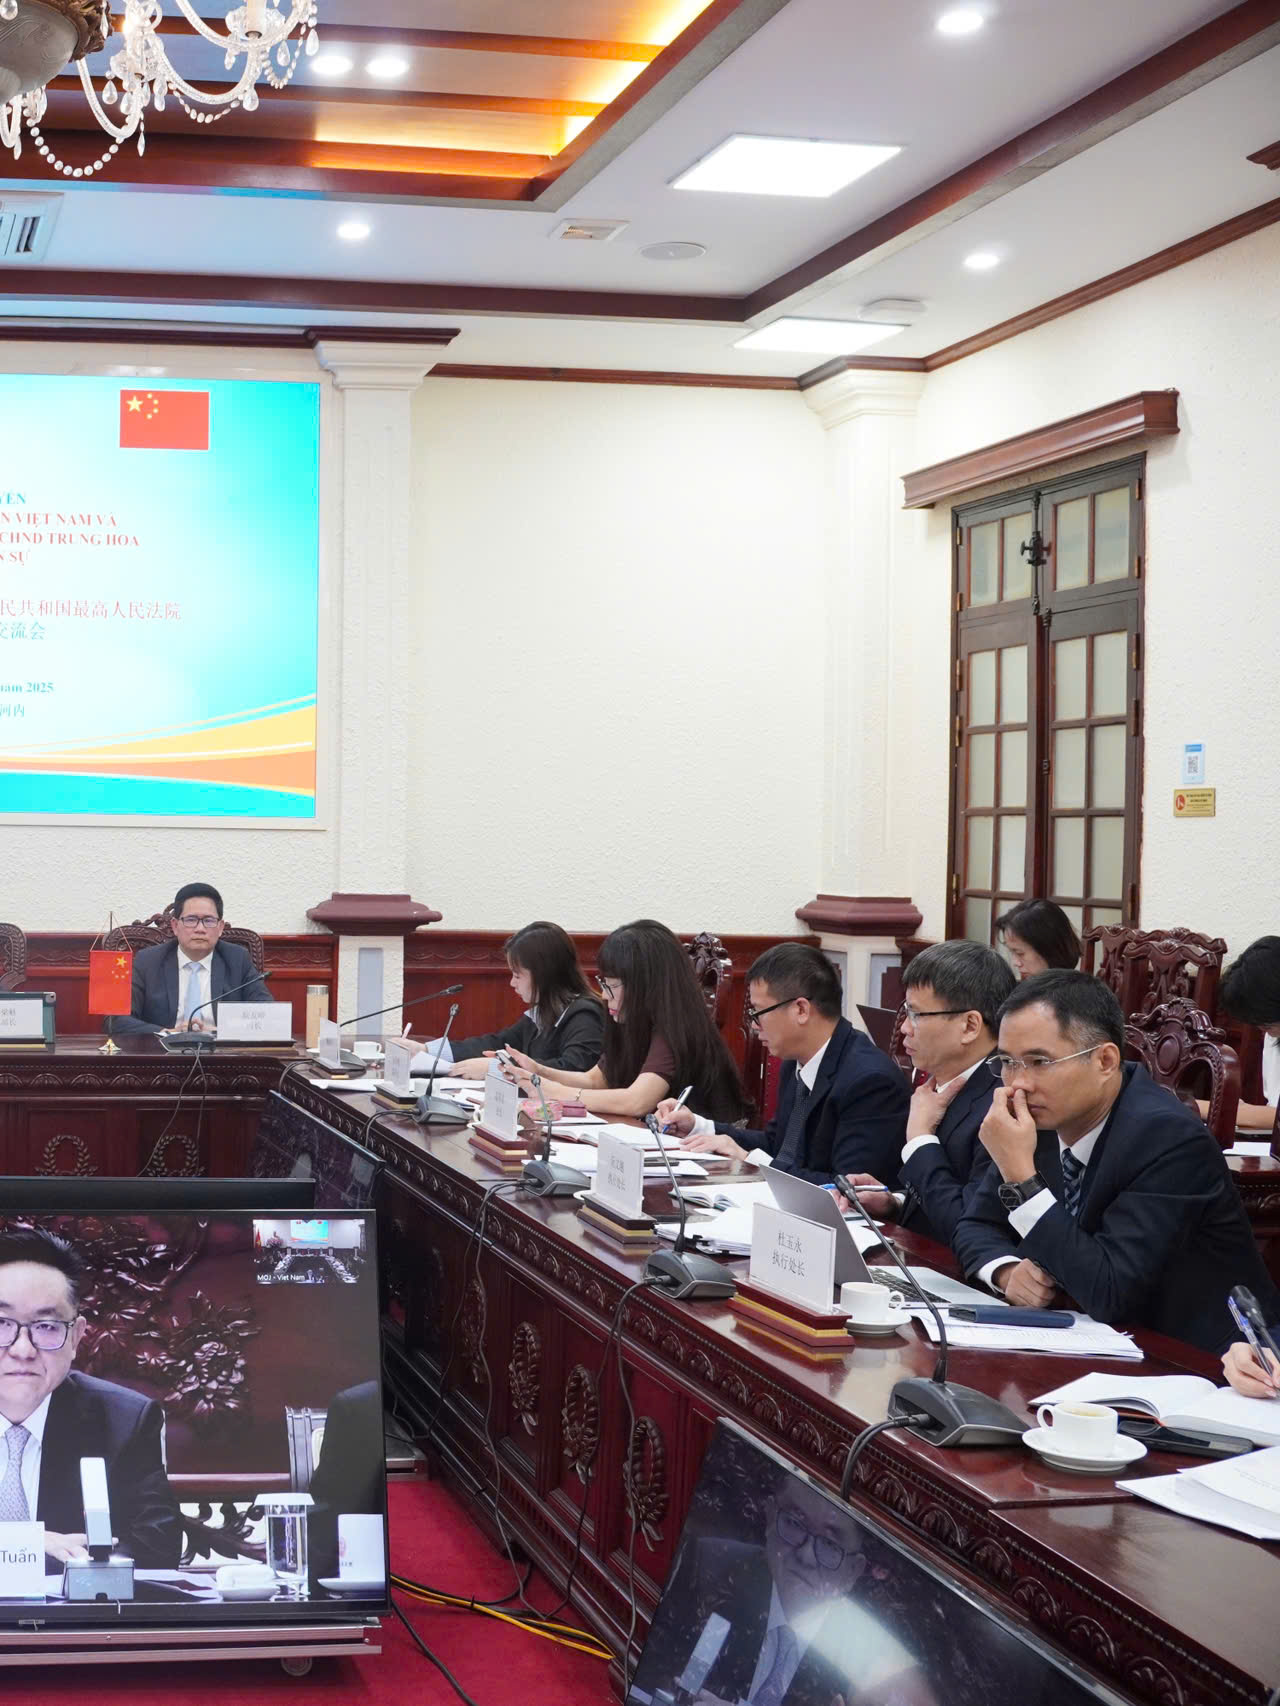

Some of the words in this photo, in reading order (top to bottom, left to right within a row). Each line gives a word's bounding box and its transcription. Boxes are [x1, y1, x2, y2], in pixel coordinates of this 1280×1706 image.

[56, 513, 92, 526] NAM
[48, 532, 102, 546] TRUNG
[106, 533, 141, 547] HOA
[26, 682, 55, 694] 2025
[771, 1249, 806, 1278] 执行处长
